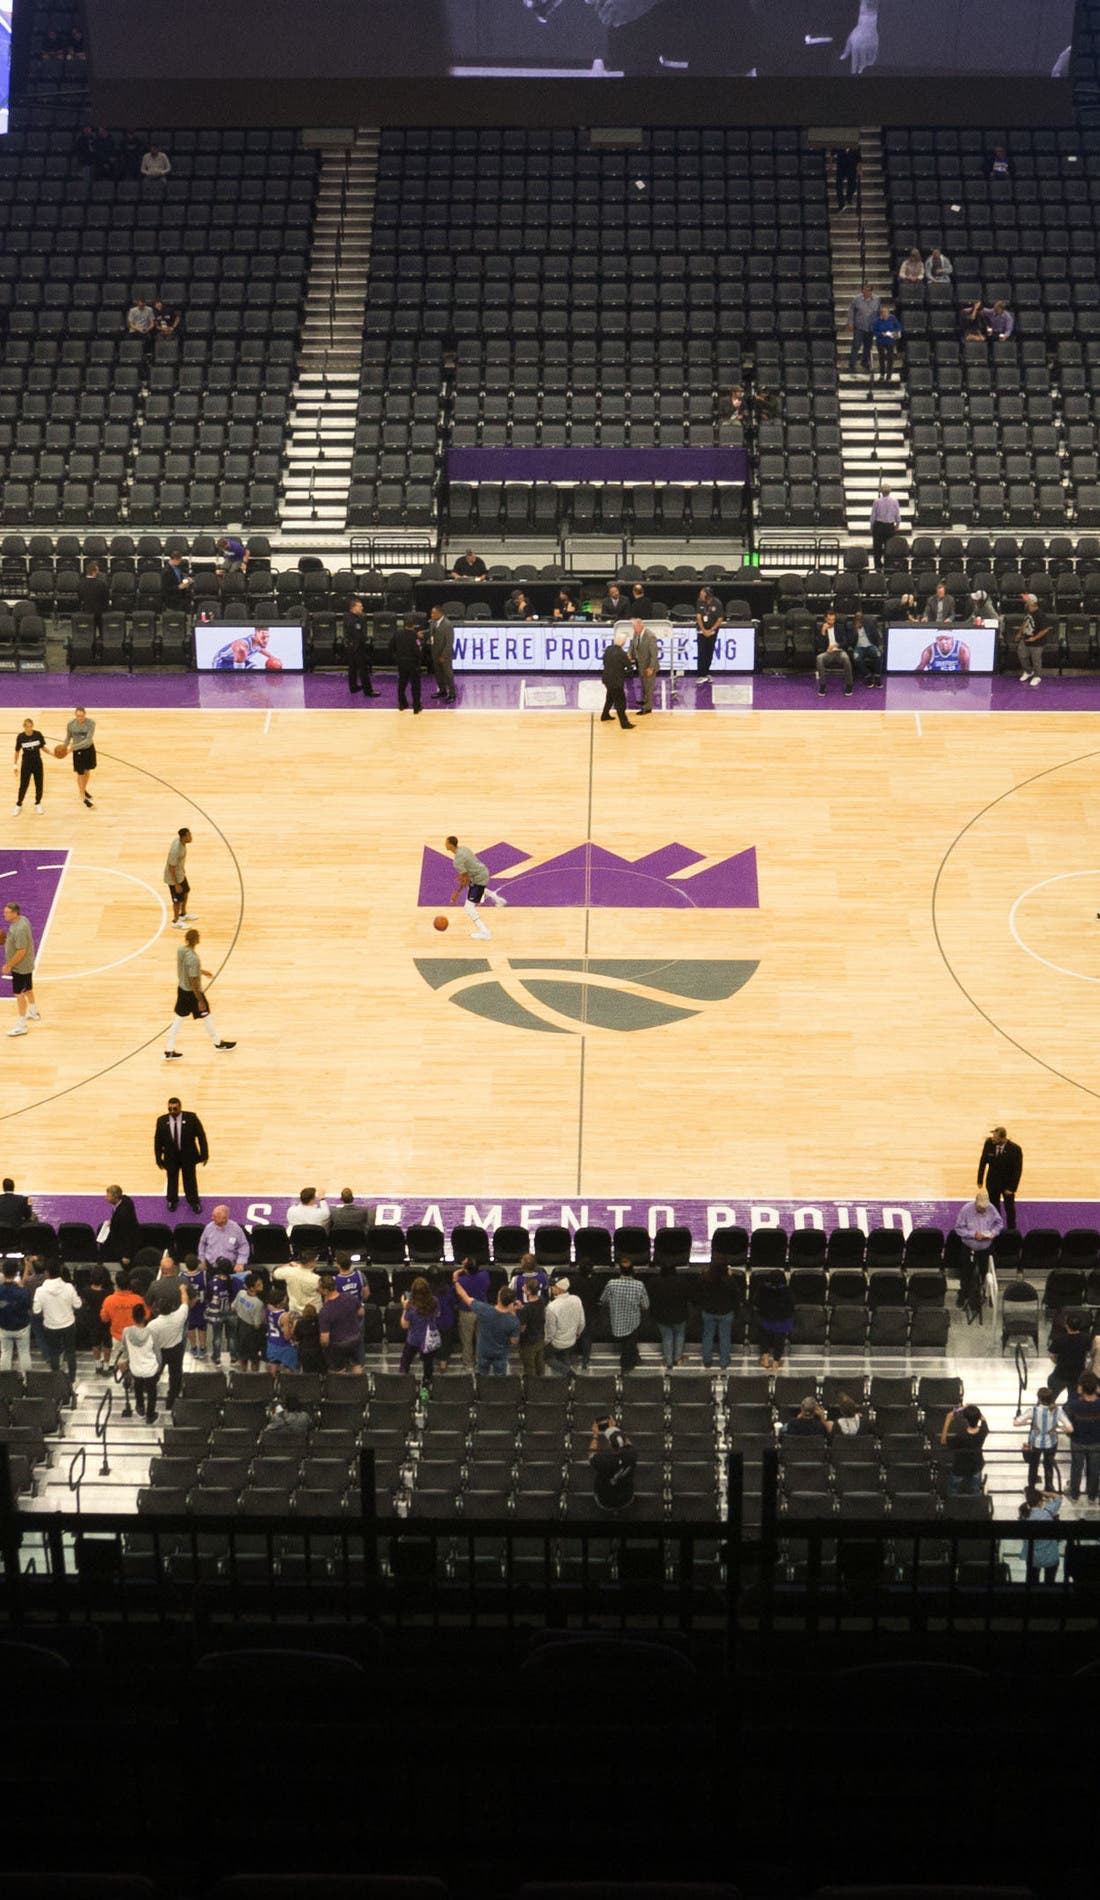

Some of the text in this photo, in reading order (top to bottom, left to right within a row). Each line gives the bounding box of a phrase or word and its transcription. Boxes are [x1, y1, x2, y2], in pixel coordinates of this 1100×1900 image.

[452, 637, 533, 660] WHERE
[546, 638, 617, 660] PROU
[246, 1203, 674, 1238] SRAMENTO
